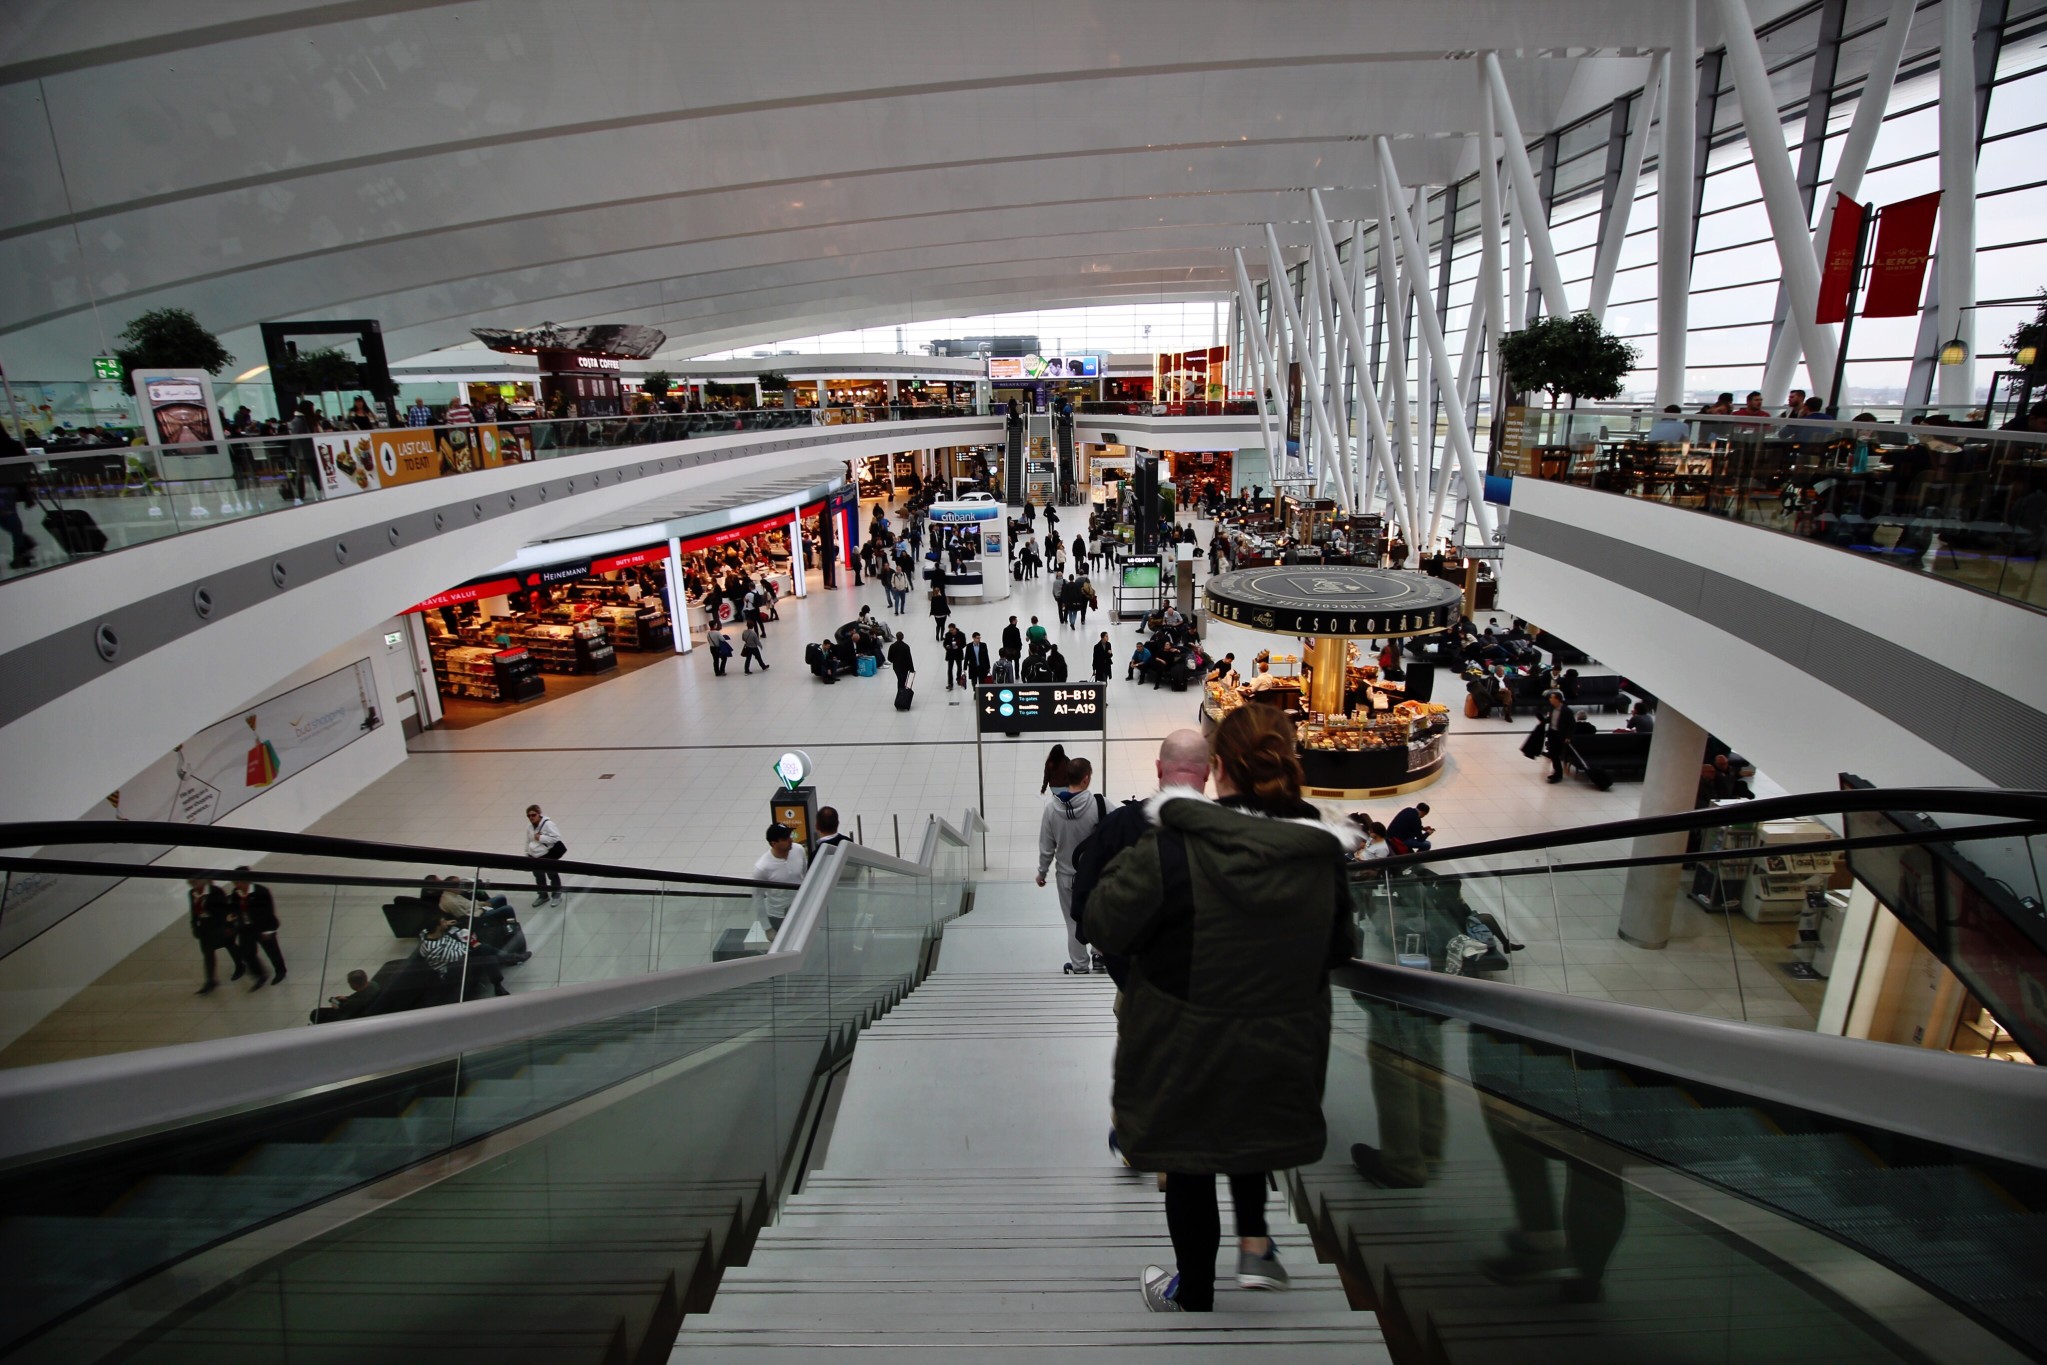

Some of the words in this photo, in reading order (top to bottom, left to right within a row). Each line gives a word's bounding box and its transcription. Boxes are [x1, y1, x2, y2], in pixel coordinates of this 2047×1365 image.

[1876, 256, 1930, 266] LEROY
[578, 356, 598, 369] COSTA
[599, 358, 620, 370] COFFEE
[397, 443, 415, 456] LAST
[416, 440, 433, 453] CALL
[404, 458, 414, 471] TO
[941, 511, 976, 522] citibank
[615, 558, 631, 566] DUTY
[632, 555, 644, 563] FREE
[543, 566, 587, 582] HEINEMANN
[418, 595, 448, 607] TRAVEL
[450, 589, 477, 601] VALUE
